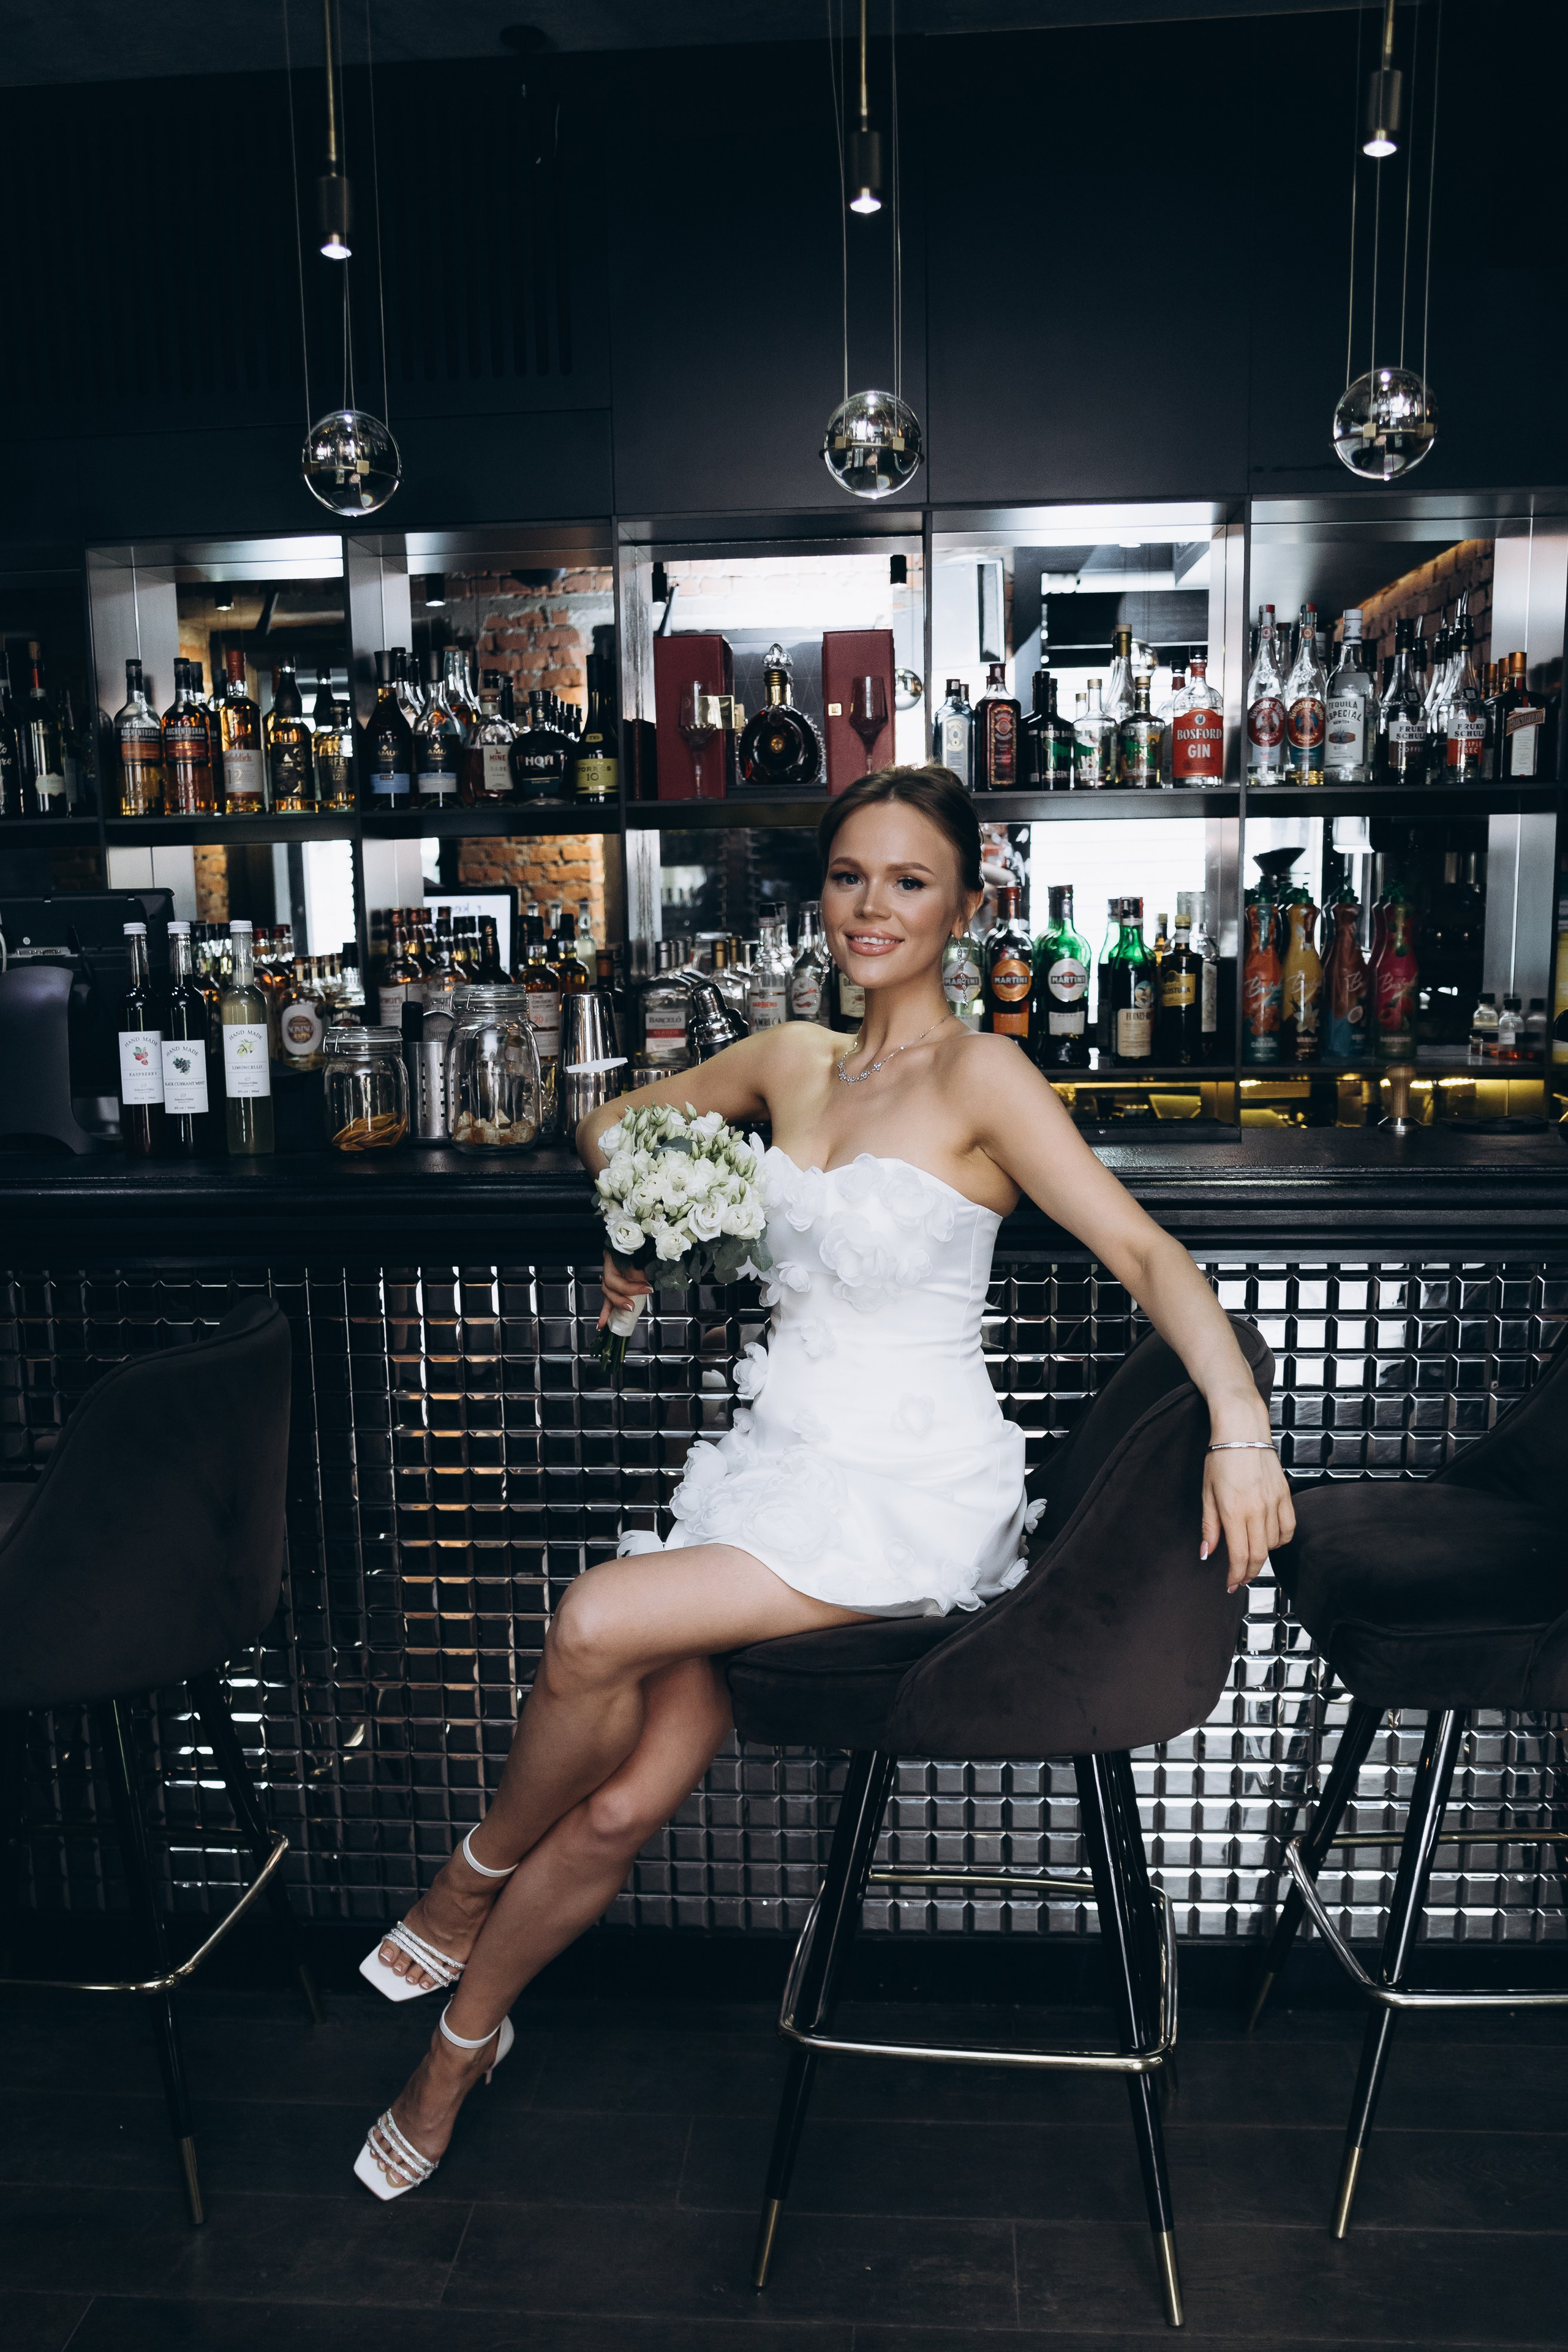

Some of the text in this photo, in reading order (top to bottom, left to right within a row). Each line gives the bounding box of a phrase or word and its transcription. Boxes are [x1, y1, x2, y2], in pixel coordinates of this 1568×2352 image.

[1328, 701, 1358, 710] TEQUILA
[1177, 728, 1222, 740] BOSFORD
[1188, 744, 1211, 758] GIN
[586, 773, 599, 782] 10
[228, 1030, 263, 1041] HAND MADE
[124, 1037, 159, 1047] HAND MADE
[166, 1046, 199, 1057] HAND MADE
